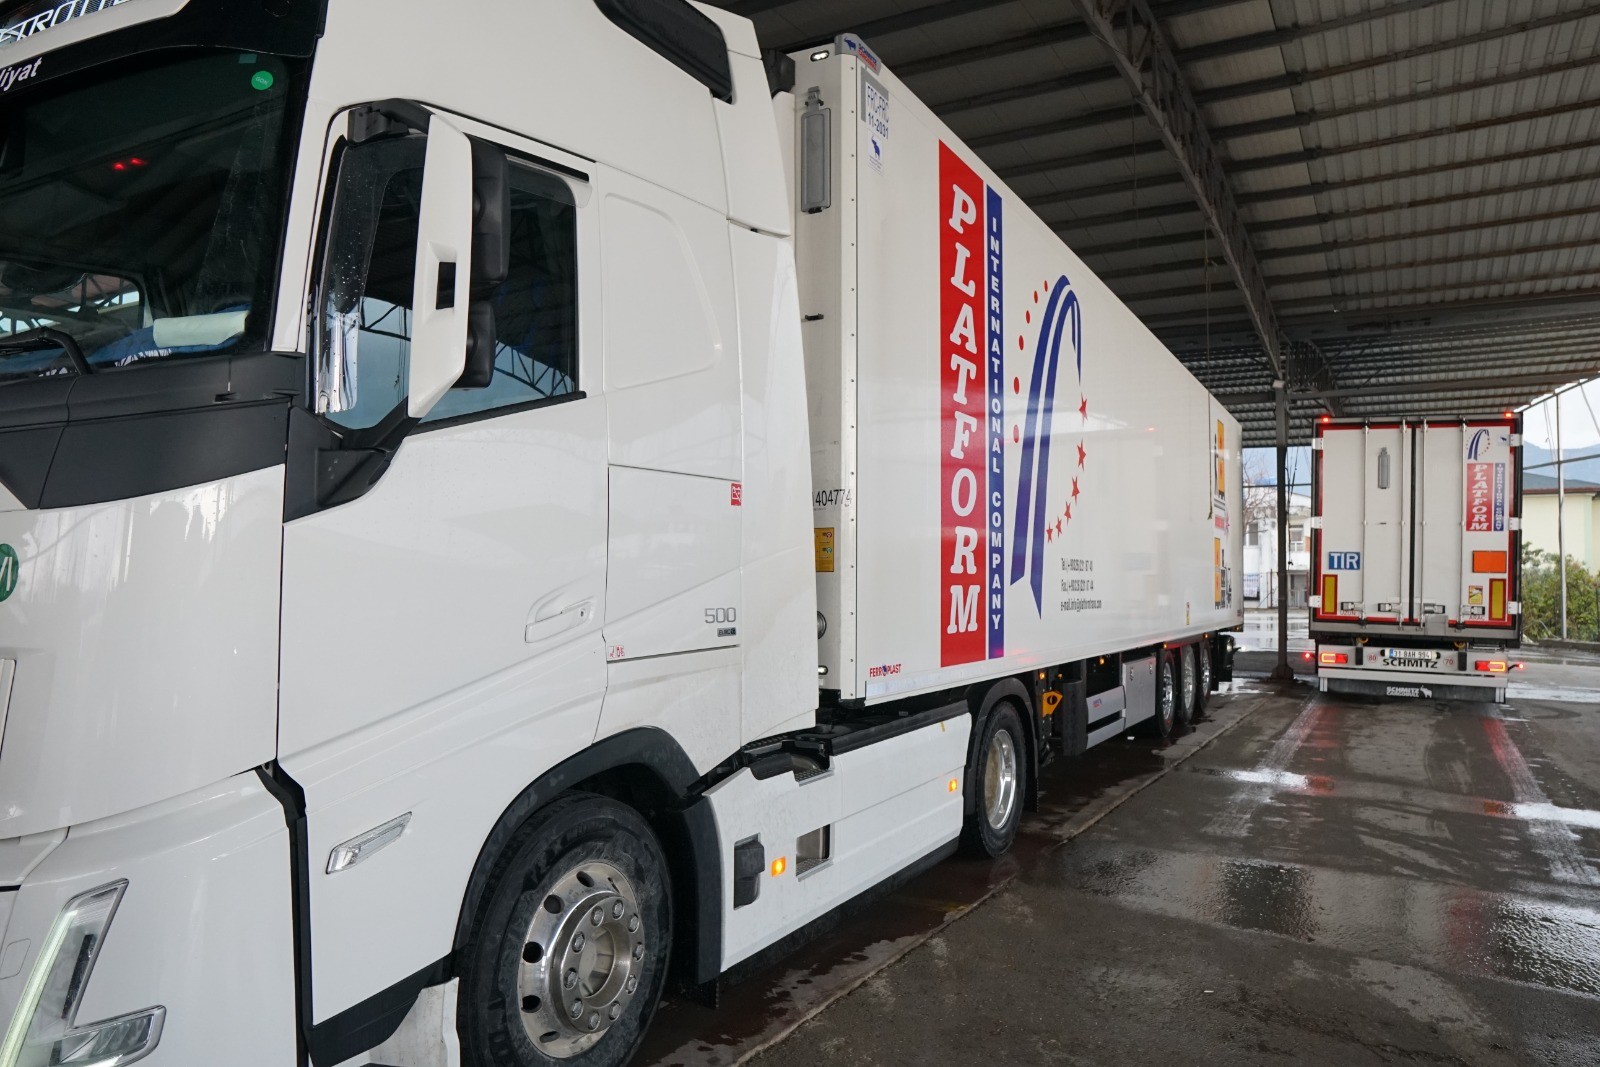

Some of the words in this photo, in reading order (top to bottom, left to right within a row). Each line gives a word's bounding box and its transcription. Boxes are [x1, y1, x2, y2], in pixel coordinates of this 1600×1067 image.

[990, 216, 1002, 474] INTERNATIONAL
[946, 183, 981, 635] PLATFORM
[1470, 464, 1490, 531] PLATFORM
[991, 491, 1003, 630] COMPANY
[1330, 552, 1359, 570] TIR
[704, 607, 737, 624] 500
[1382, 658, 1438, 669] SCHMITZ
